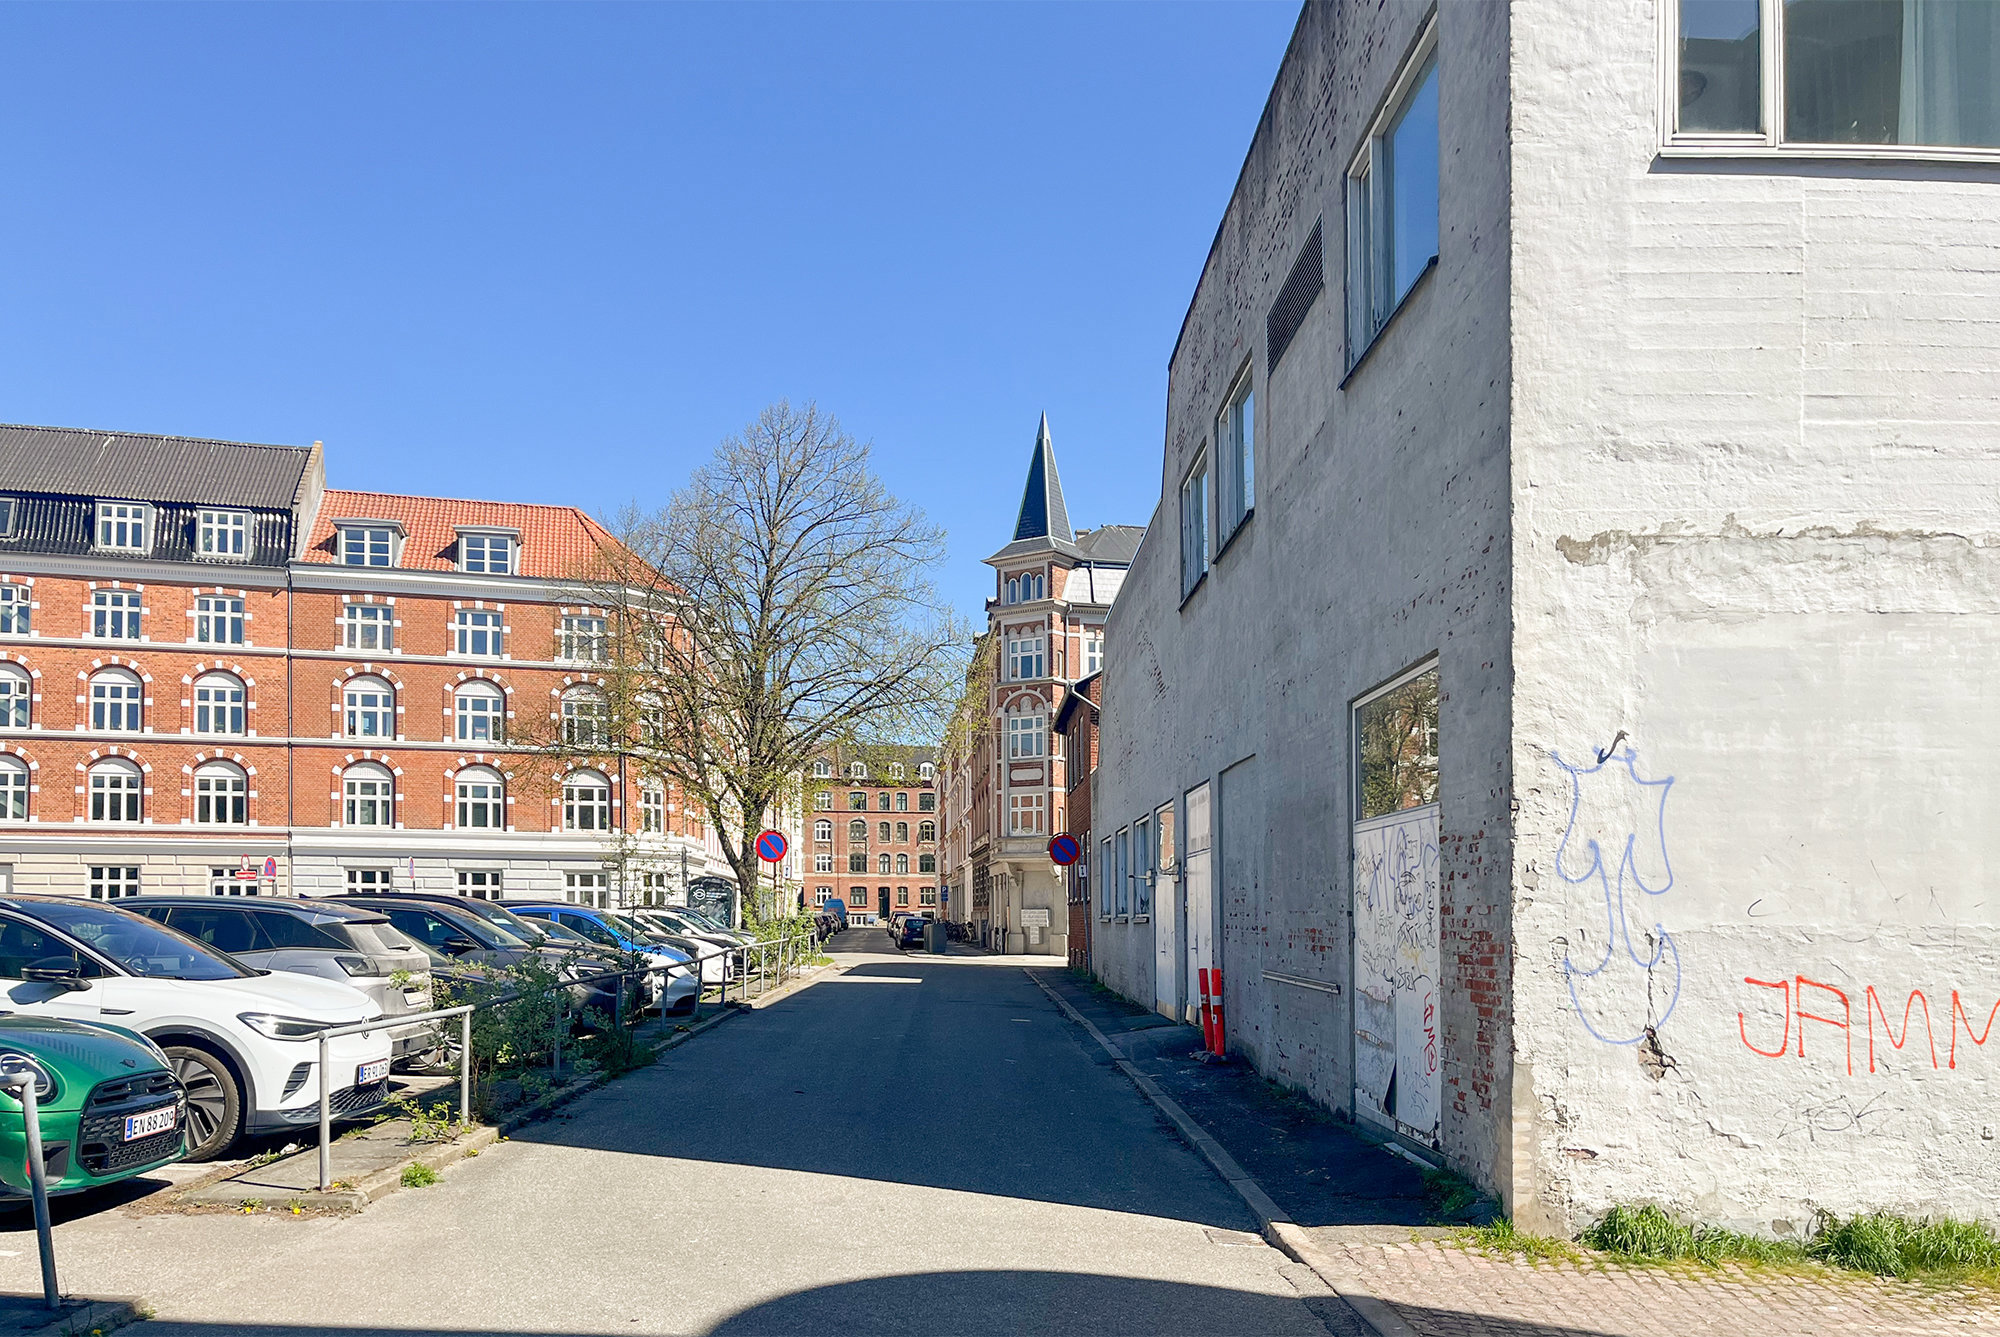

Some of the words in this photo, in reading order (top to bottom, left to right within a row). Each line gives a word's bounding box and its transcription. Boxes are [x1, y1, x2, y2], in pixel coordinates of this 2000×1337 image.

[133, 1118, 146, 1135] EN
[147, 1115, 158, 1131] 88
[159, 1110, 174, 1128] 209
